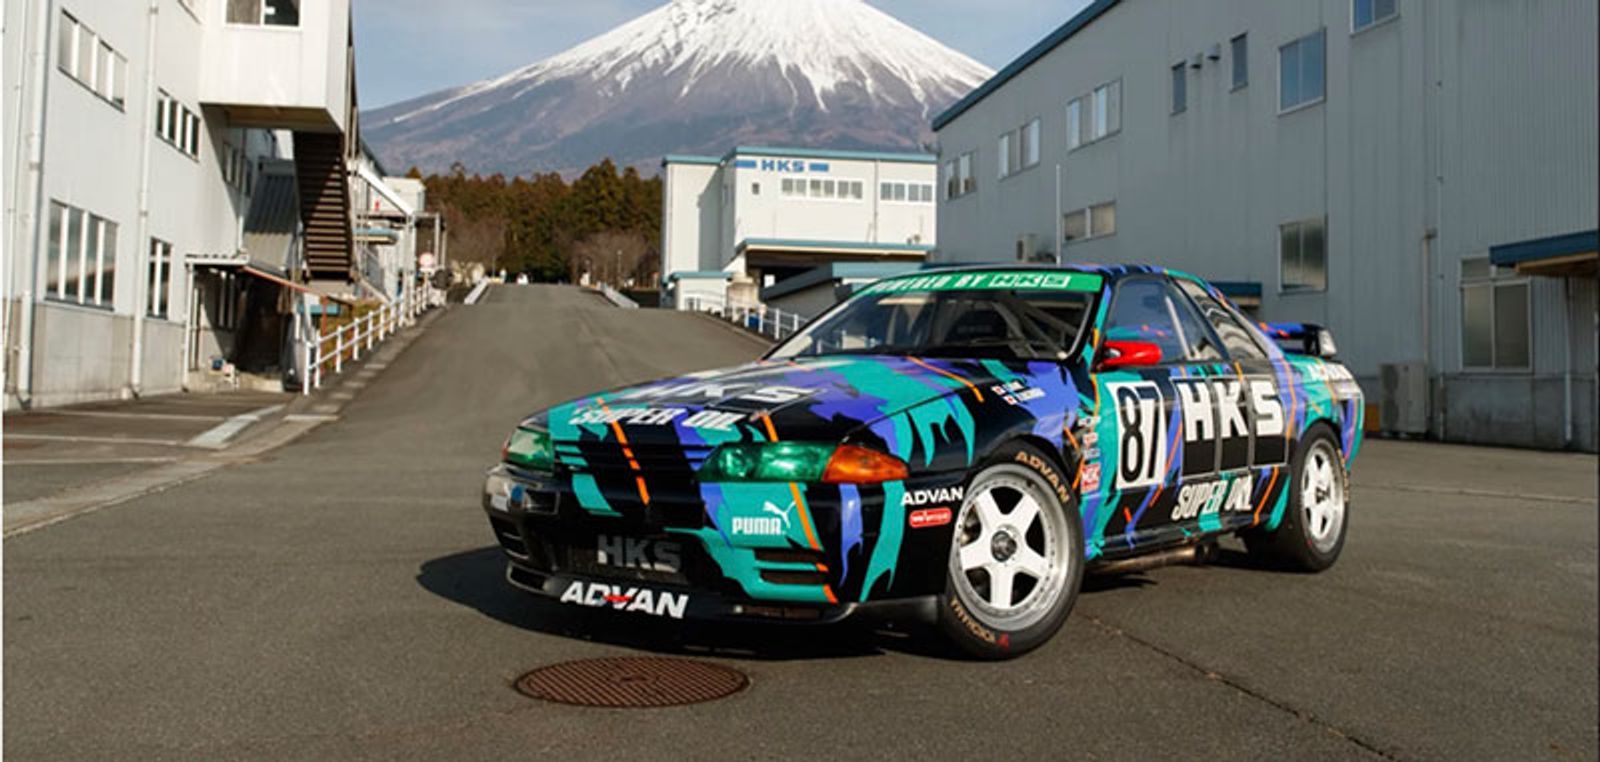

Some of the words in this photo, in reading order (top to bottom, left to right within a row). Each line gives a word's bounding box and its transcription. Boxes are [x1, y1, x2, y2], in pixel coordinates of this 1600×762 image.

[761, 159, 805, 173] HKS
[954, 274, 986, 289] BY
[988, 273, 1071, 289] HKS
[568, 406, 688, 426] SUPER
[681, 410, 747, 431] OIL
[1176, 379, 1284, 442] HKS
[1116, 385, 1161, 483] 87
[900, 486, 963, 506] ADVAN
[1015, 451, 1070, 503] ADVAN
[1171, 480, 1228, 521] SUPER
[1223, 474, 1253, 511] OIL
[731, 516, 782, 535] PUMA
[597, 533, 681, 573] HKS
[560, 580, 690, 619] ADVAN
